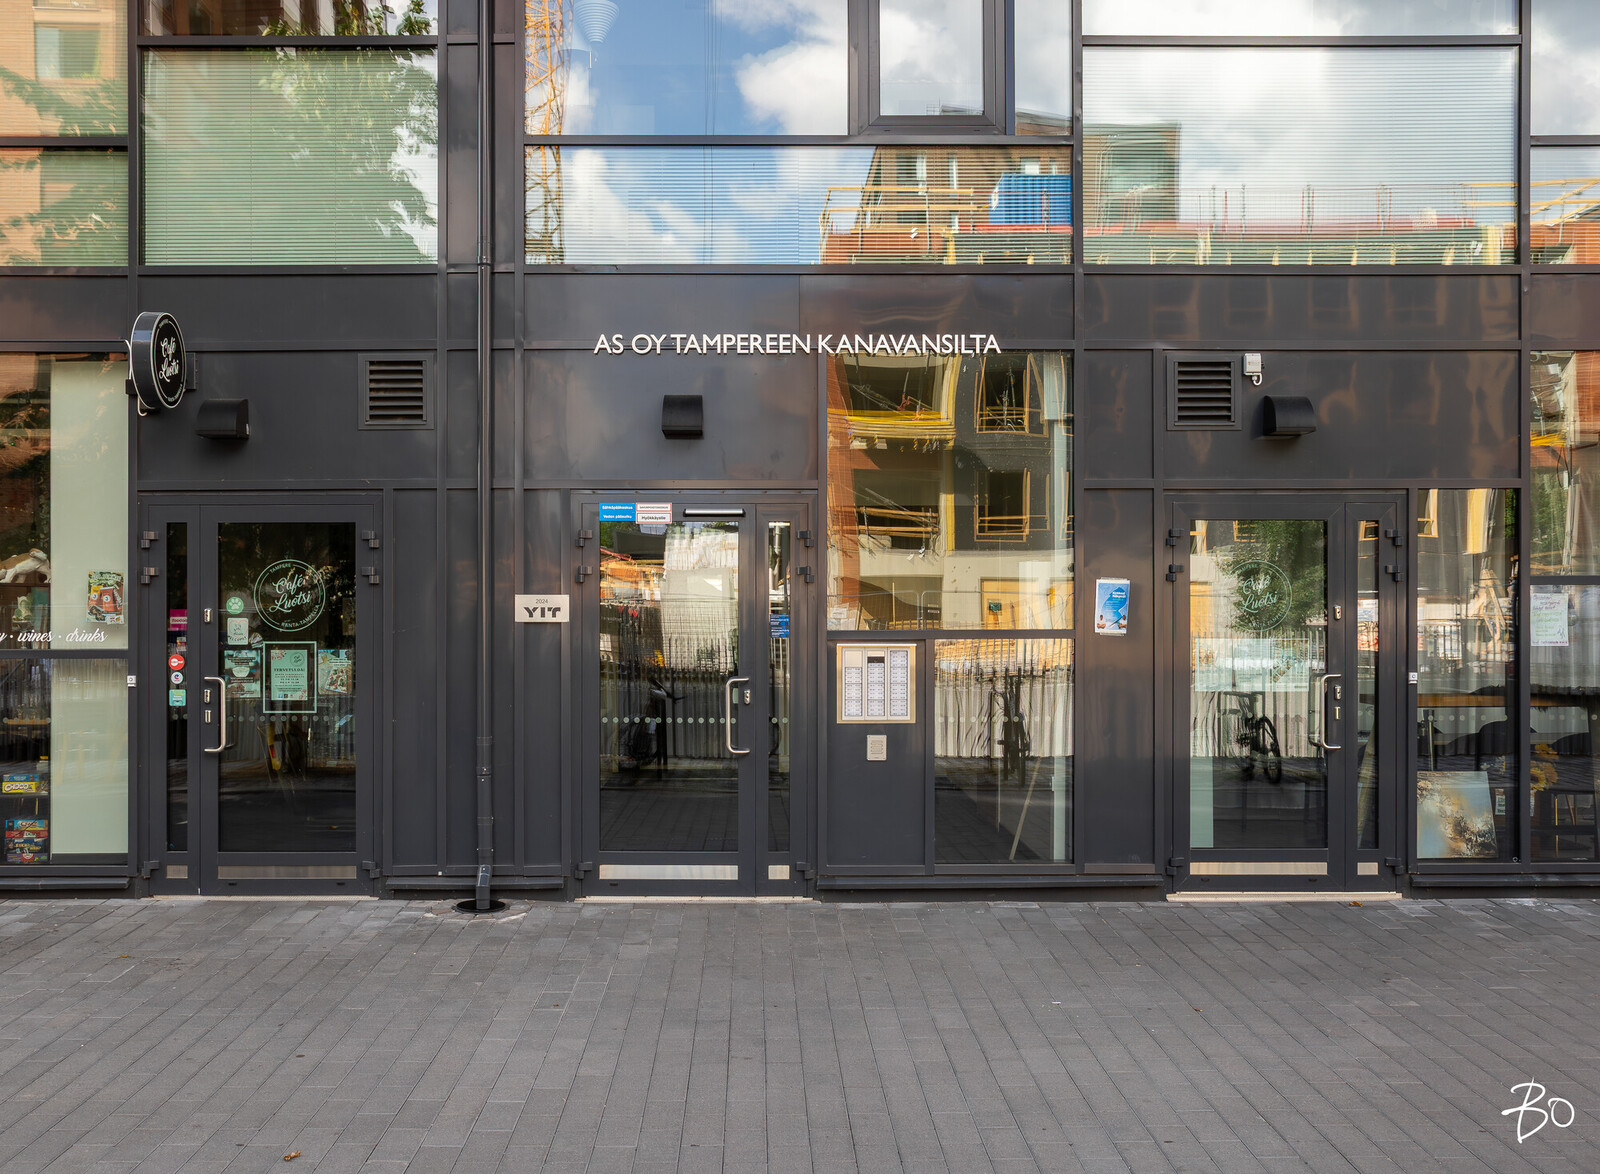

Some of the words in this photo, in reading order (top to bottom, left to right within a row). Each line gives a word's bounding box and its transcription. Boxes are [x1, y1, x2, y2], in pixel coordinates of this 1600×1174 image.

[593, 333, 624, 355] AS
[631, 333, 667, 355] OY
[670, 333, 811, 355] TAMPEREEN
[817, 333, 1002, 355] KANAVANSILTA
[269, 563, 292, 574] TAMPERE
[272, 573, 304, 595] Café
[269, 590, 312, 613] Luotsi
[523, 606, 561, 618] YIT
[1240, 591, 1279, 613] Luotsi
[17, 629, 55, 643] wines
[65, 627, 108, 643] drinks
